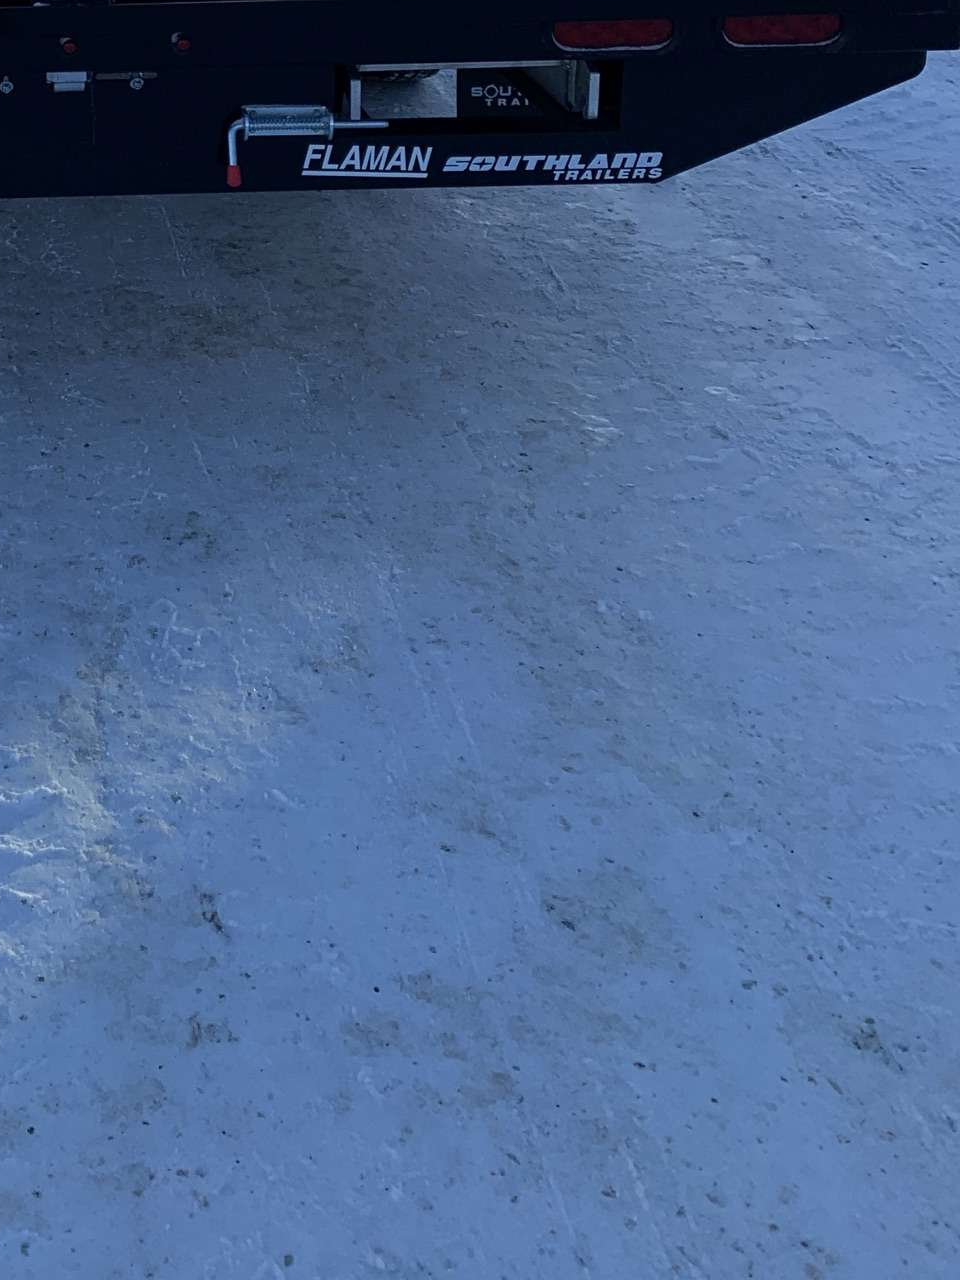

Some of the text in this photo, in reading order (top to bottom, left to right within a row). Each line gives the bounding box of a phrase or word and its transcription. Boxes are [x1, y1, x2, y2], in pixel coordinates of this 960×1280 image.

[471, 85, 512, 98] SOU
[304, 144, 432, 172] FLAMAN
[442, 152, 664, 172] SOUTHLAND
[553, 167, 663, 181] TRAILERS
